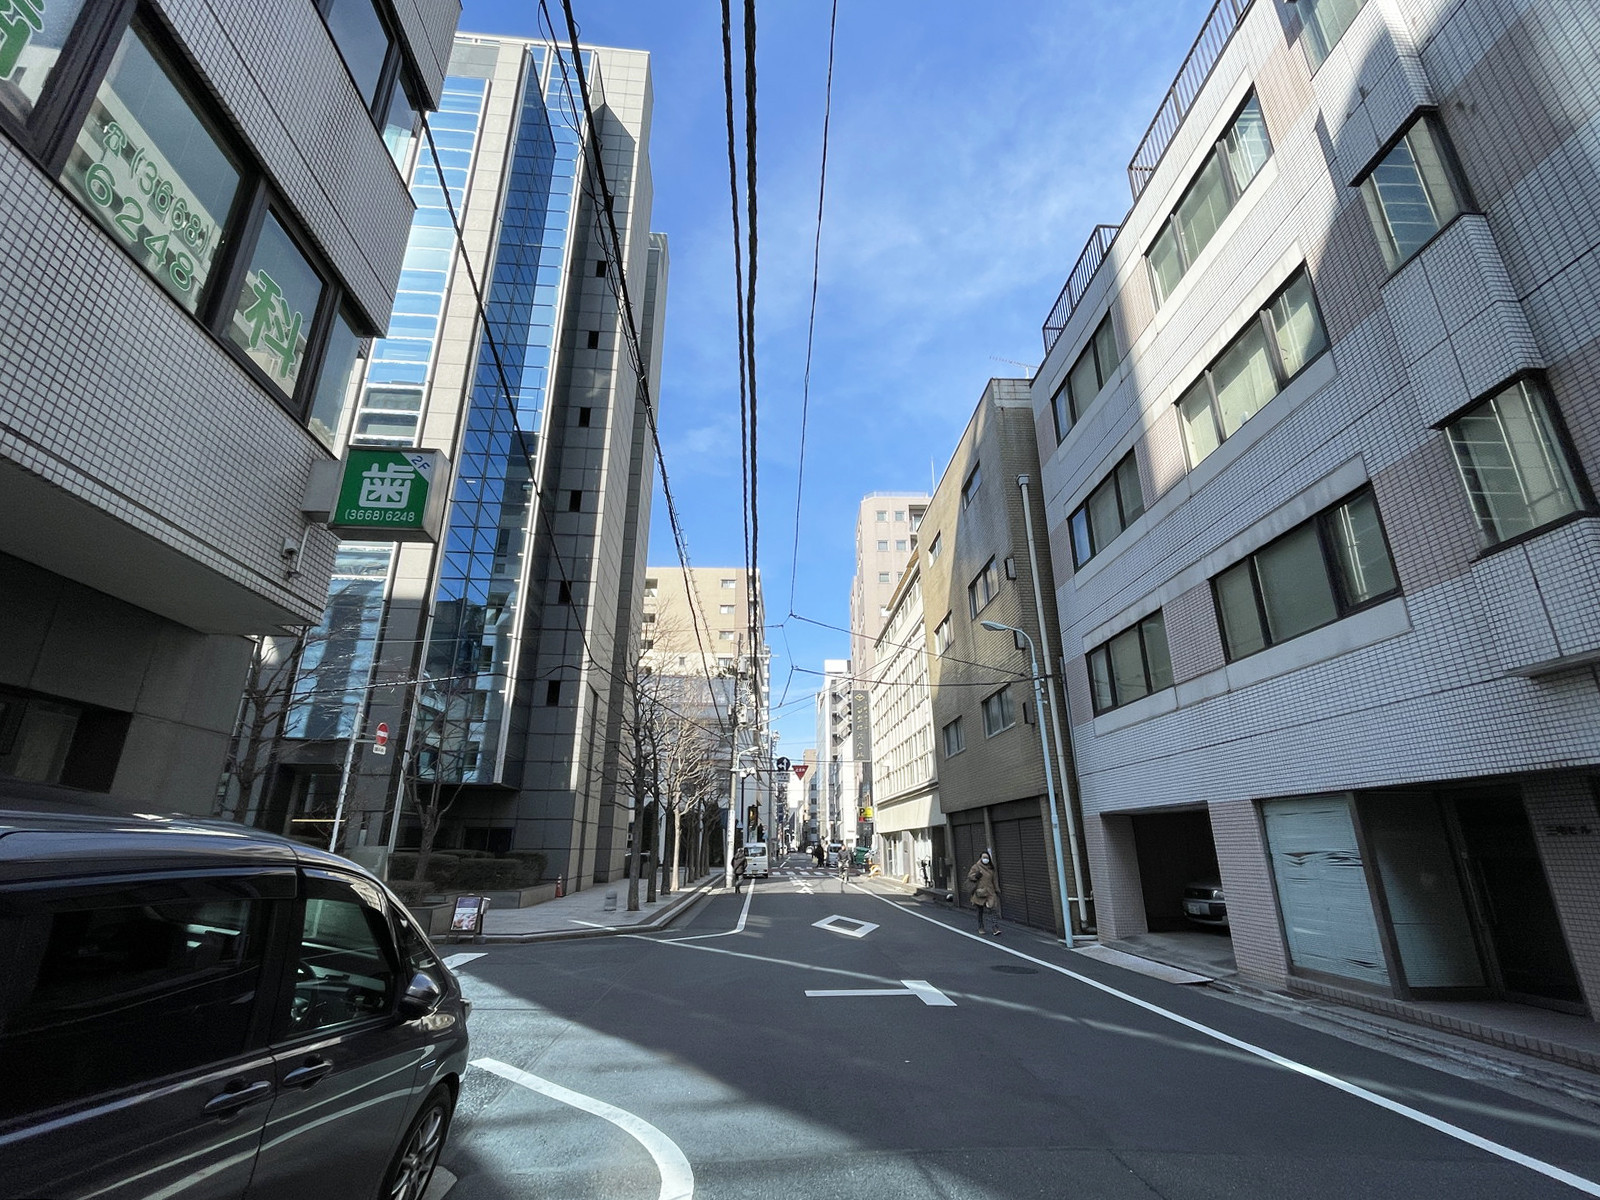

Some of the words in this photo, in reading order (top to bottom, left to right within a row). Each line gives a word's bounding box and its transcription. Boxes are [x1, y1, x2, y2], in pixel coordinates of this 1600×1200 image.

[131, 147, 210, 257] (3668)
[85, 162, 194, 292] 6248
[242, 269, 302, 380] 科
[358, 462, 416, 509] 歯
[411, 455, 430, 471] 2F
[344, 508, 415, 522] (3668)6248
[859, 808, 865, 816] P
